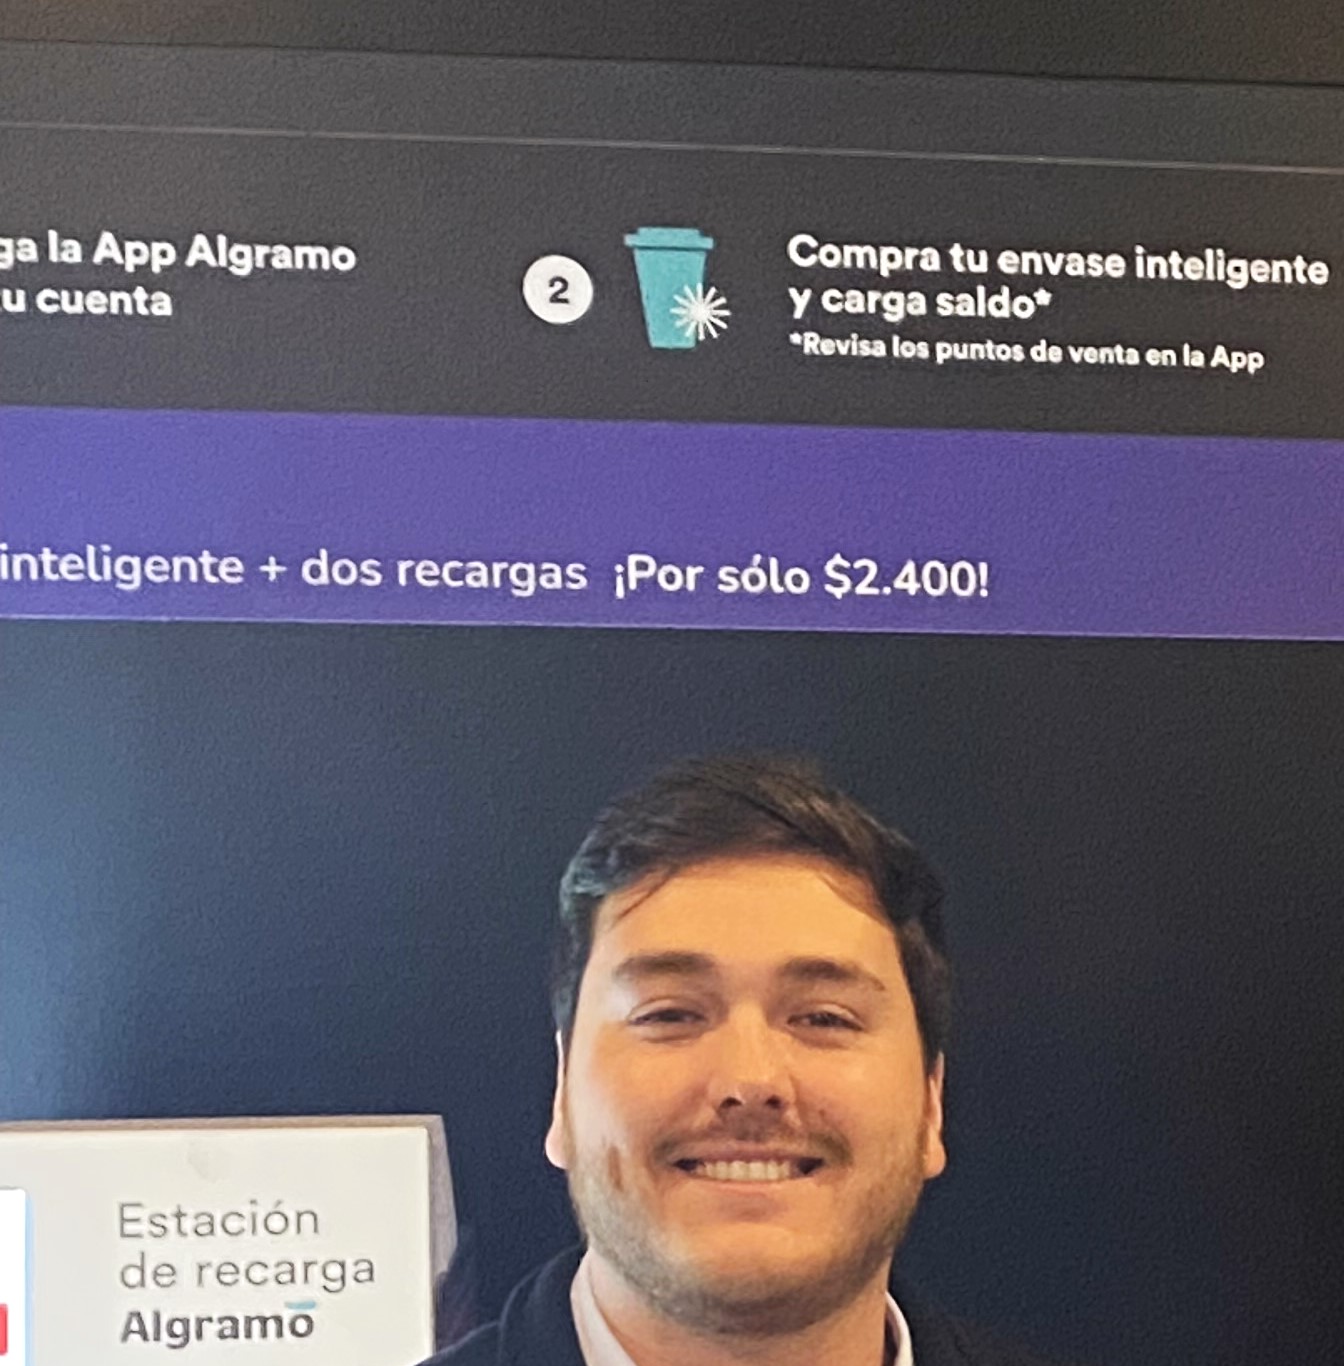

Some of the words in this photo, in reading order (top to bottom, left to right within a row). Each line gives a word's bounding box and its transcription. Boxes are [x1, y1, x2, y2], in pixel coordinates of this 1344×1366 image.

[47, 229, 83, 264] la
[92, 231, 177, 274] App
[184, 233, 357, 277] Algramo
[787, 233, 941, 278] Compra
[948, 242, 988, 273] tu
[996, 250, 1126, 278] envase
[1135, 244, 1330, 290] inteligente
[1, 288, 26, 313] u
[35, 285, 173, 316] cuenta
[548, 275, 570, 305] 2
[788, 287, 812, 320] y
[821, 288, 927, 323] carga
[892, 334, 930, 359] los
[935, 339, 1026, 365] puntos
[1029, 339, 1063, 364] de
[1067, 344, 1140, 366] venta
[1145, 348, 1177, 366] en
[1182, 342, 1205, 367] la
[1210, 344, 1265, 375] App
[0, 542, 245, 591] inteligente
[259, 556, 287, 582] +
[301, 548, 383, 587] dos
[397, 559, 588, 597] recargas
[614, 553, 705, 599] ¡Por
[717, 553, 810, 595] sólo
[824, 552, 989, 600] $2.400!
[118, 1199, 320, 1239] Estación
[119, 1250, 177, 1290] de
[197, 1258, 375, 1294] recarga
